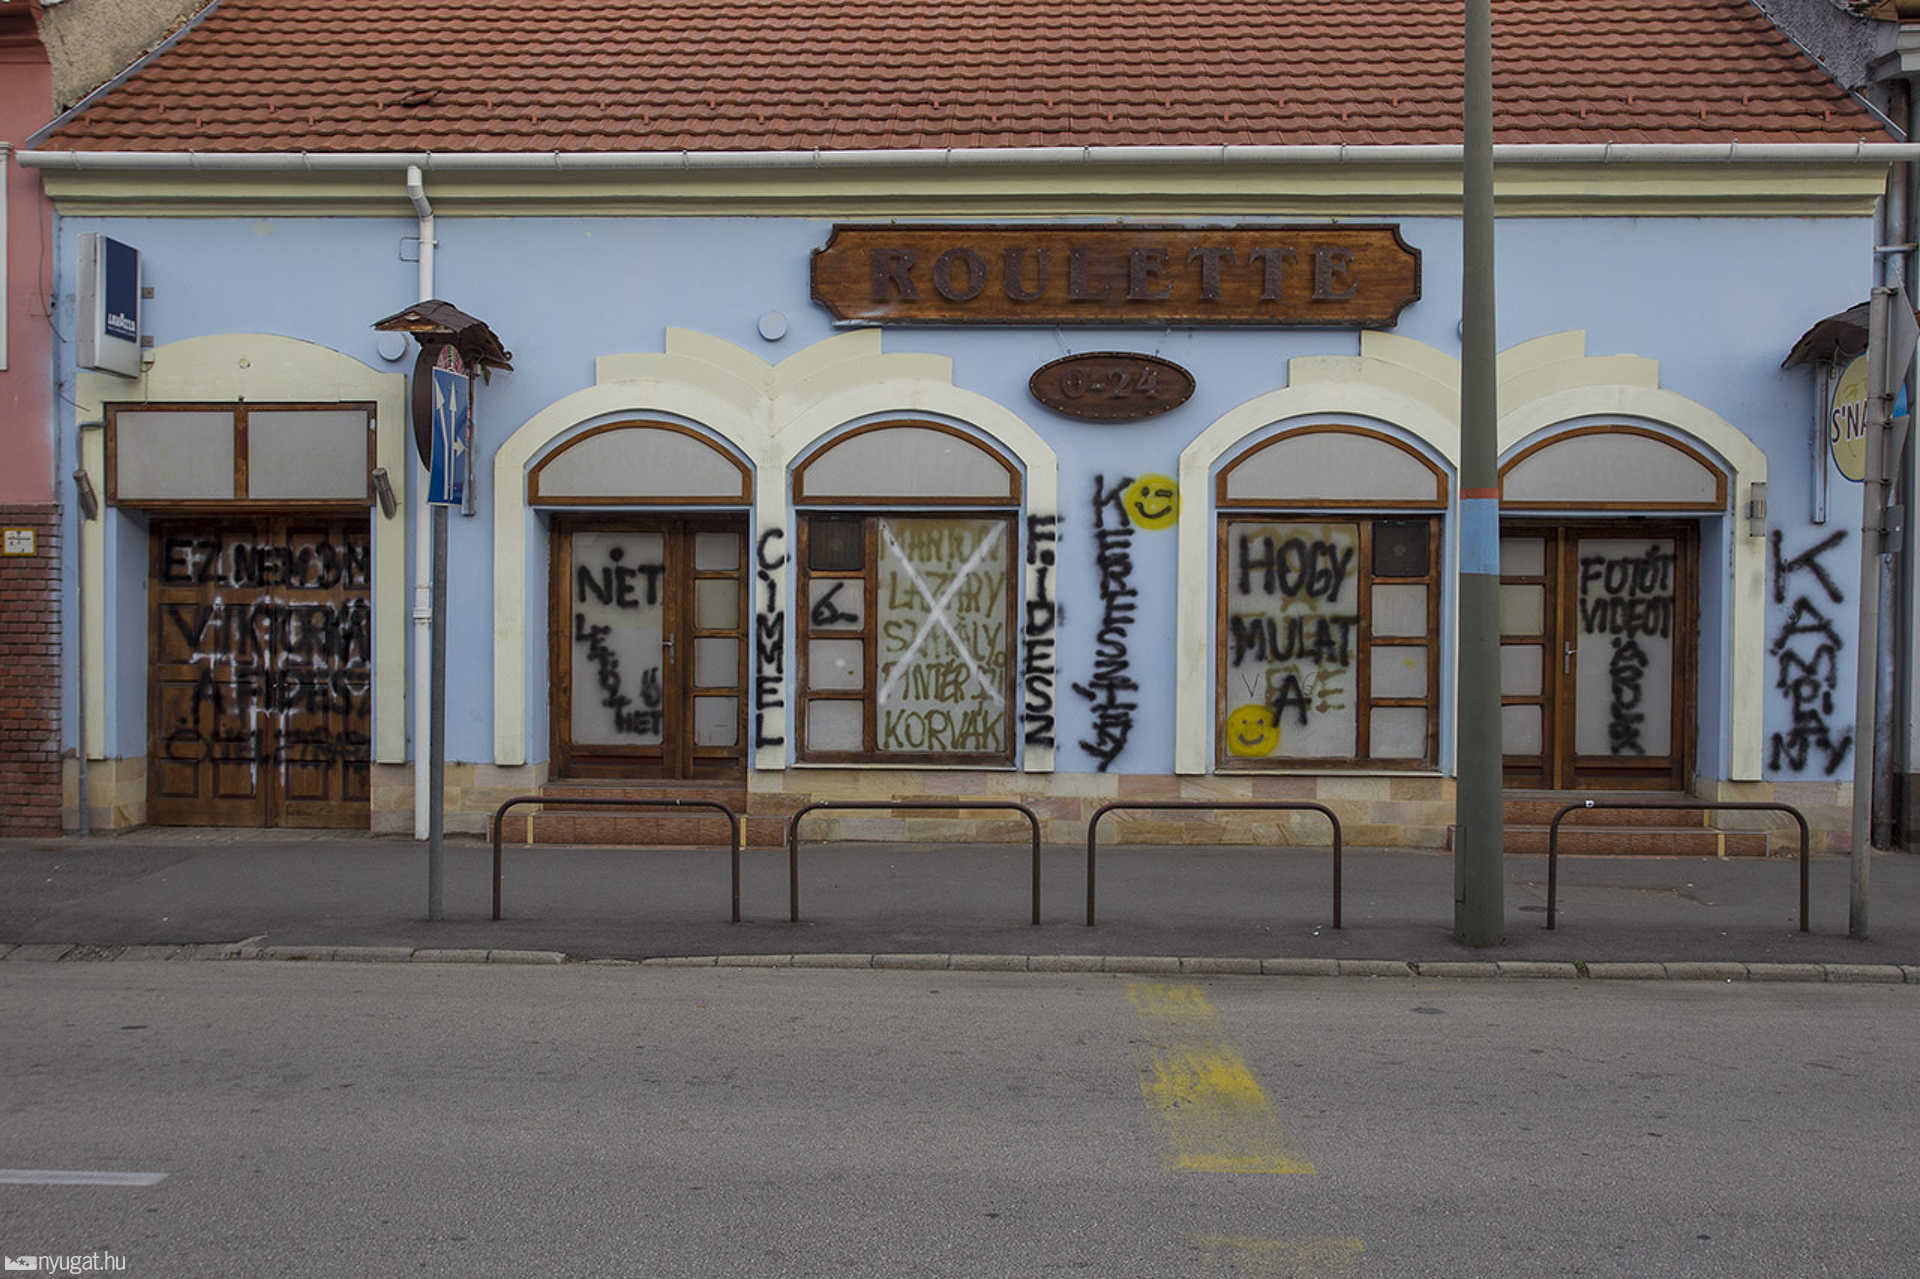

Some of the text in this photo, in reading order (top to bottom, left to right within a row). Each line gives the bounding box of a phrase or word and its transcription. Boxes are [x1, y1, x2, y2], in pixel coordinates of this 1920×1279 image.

[870, 245, 1359, 301] ROULETTE
[1059, 367, 1161, 400] 0-24
[1238, 534, 1354, 602] HOGY
[1231, 615, 1361, 668] MULAT
